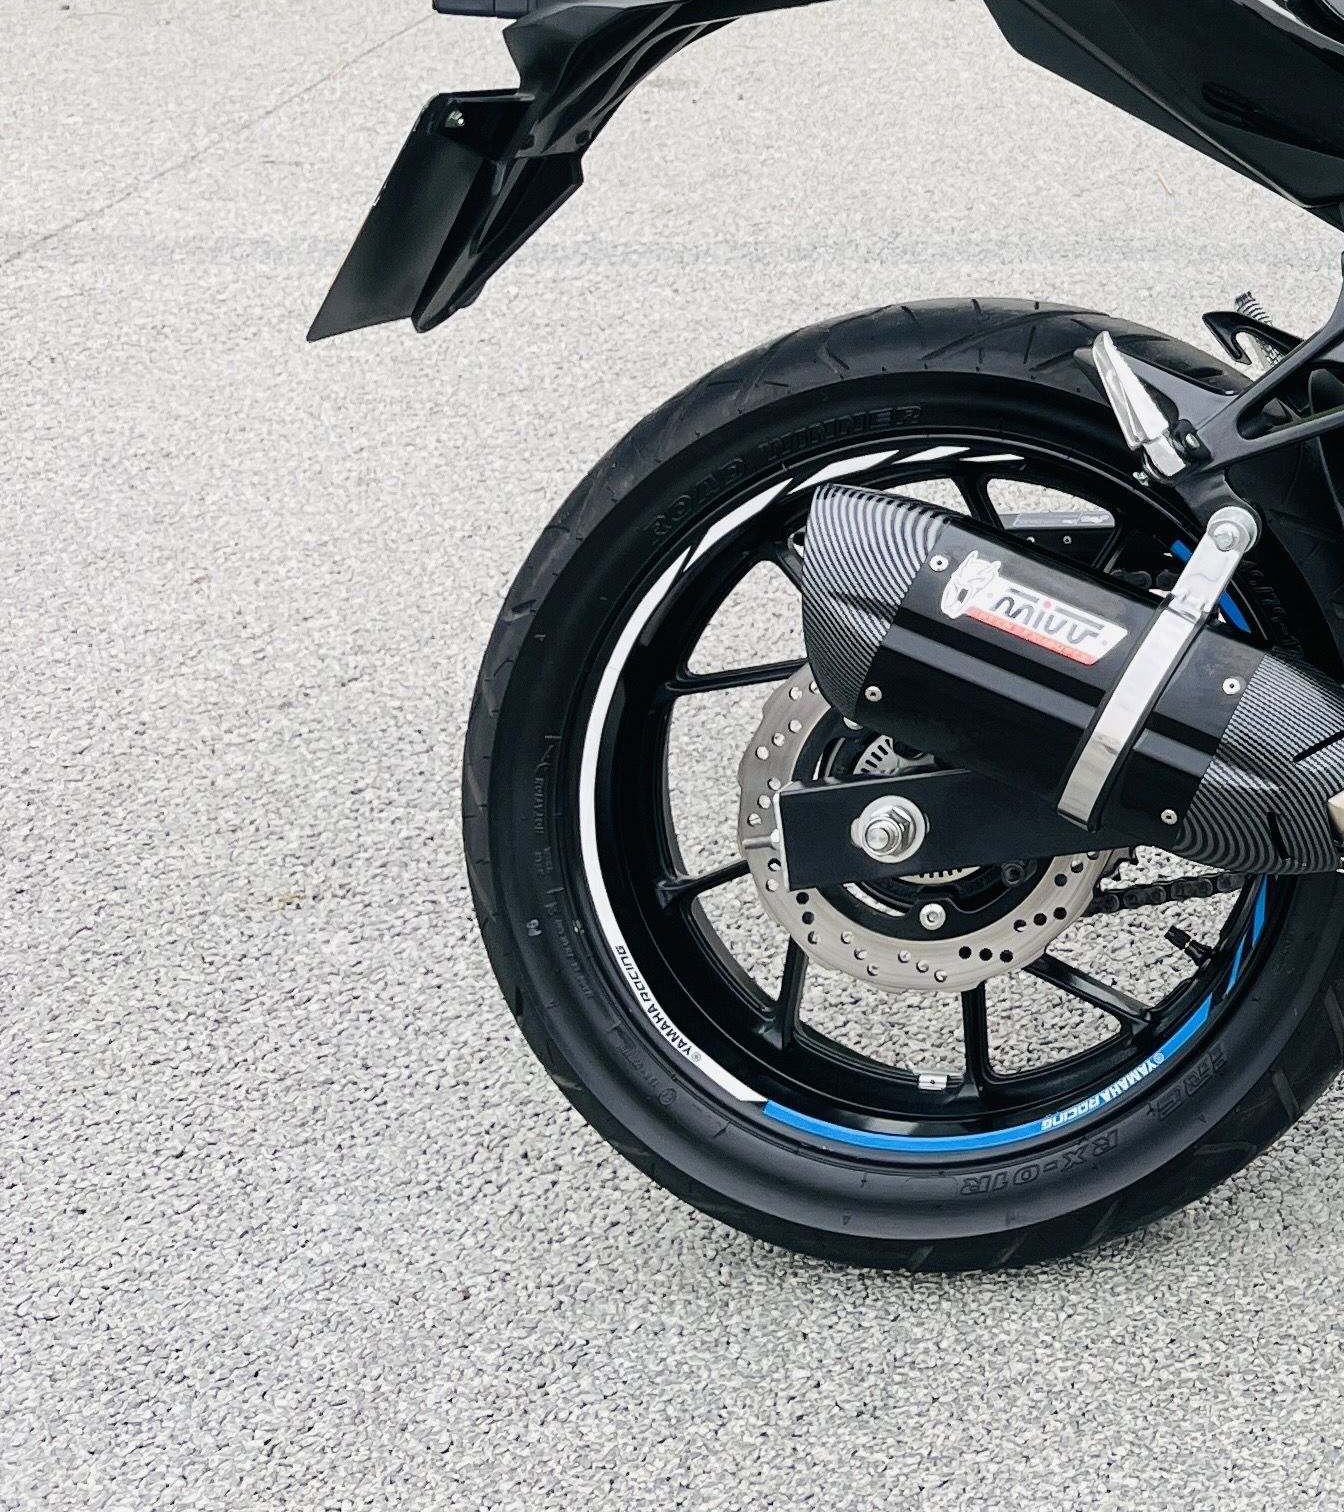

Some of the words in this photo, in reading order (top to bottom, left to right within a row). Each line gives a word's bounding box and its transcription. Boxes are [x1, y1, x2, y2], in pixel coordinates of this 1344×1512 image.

[615, 944, 654, 1006] RACING
[645, 1001, 693, 1057] YAMAHA
[1098, 1061, 1156, 1110] YAMAHA
